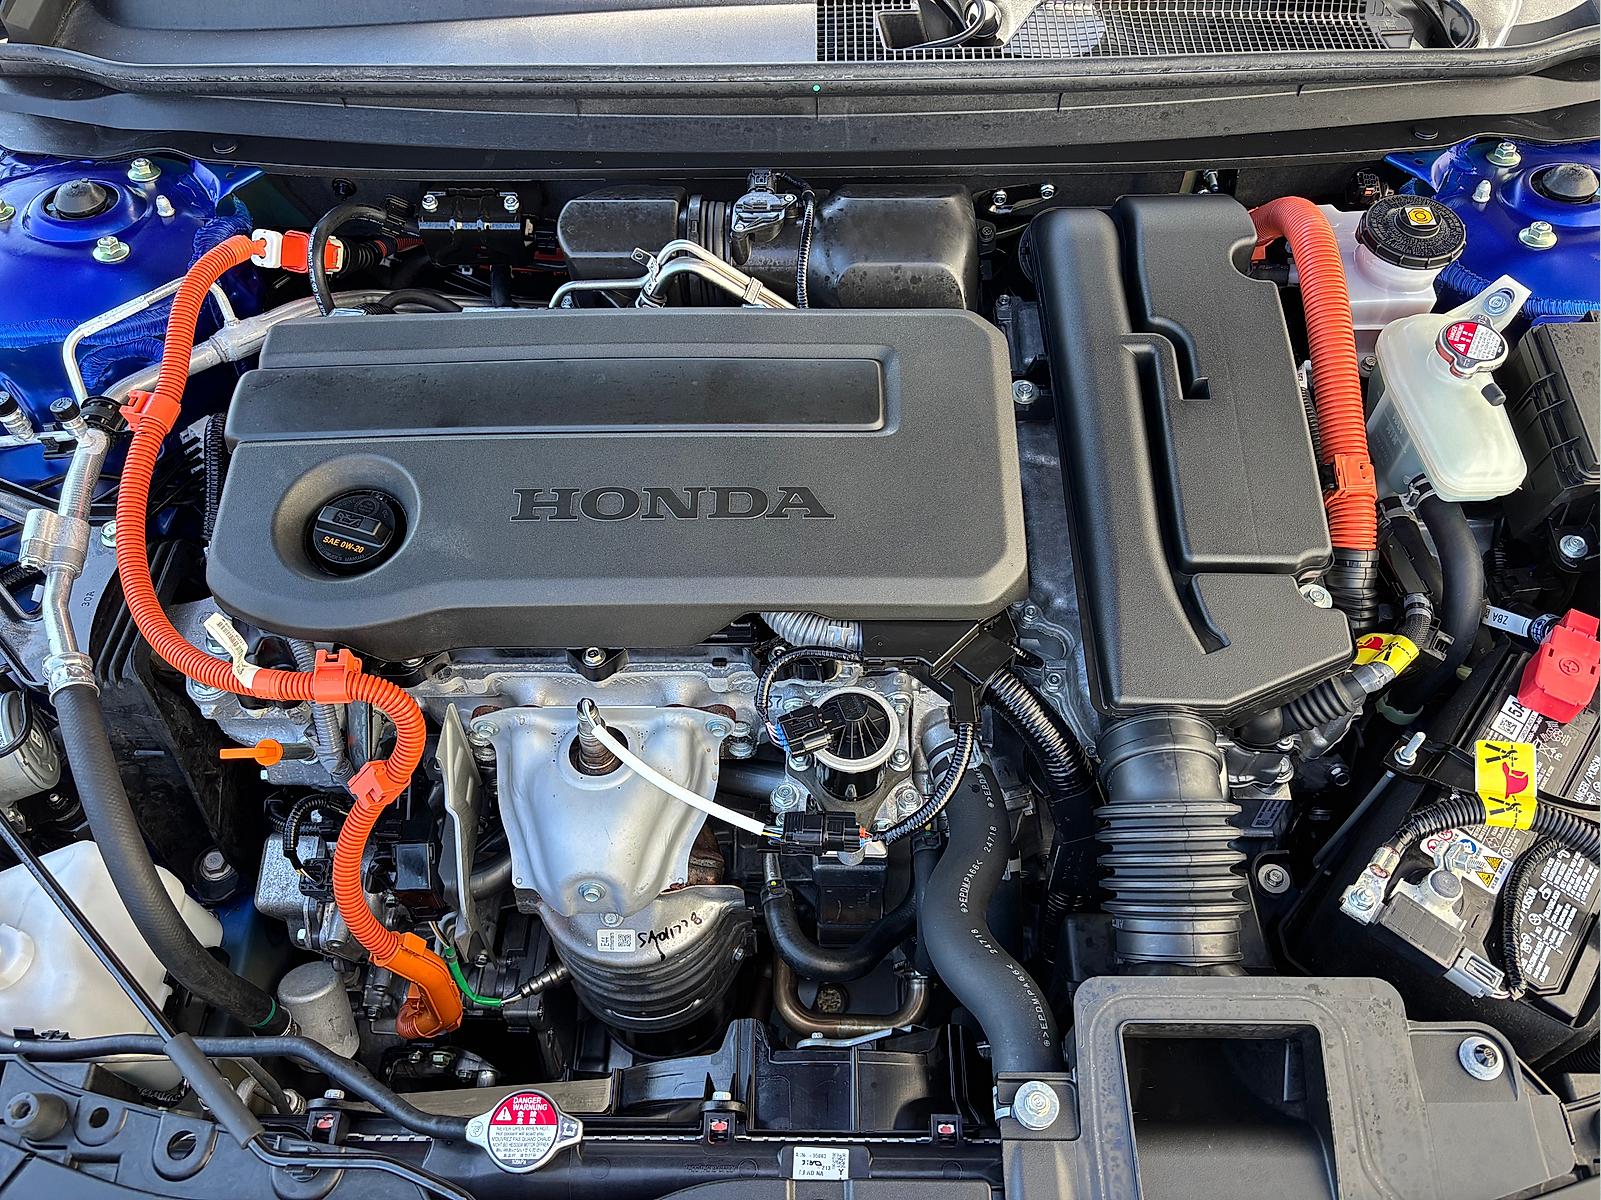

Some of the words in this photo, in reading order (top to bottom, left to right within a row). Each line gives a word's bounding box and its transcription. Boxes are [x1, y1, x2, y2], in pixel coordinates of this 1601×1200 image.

[510, 486, 836, 521] HONDA
[322, 536, 339, 547] SAE
[340, 541, 365, 554] 0W-20
[984, 825, 998, 853] 24718
[971, 928, 998, 954] 24718
